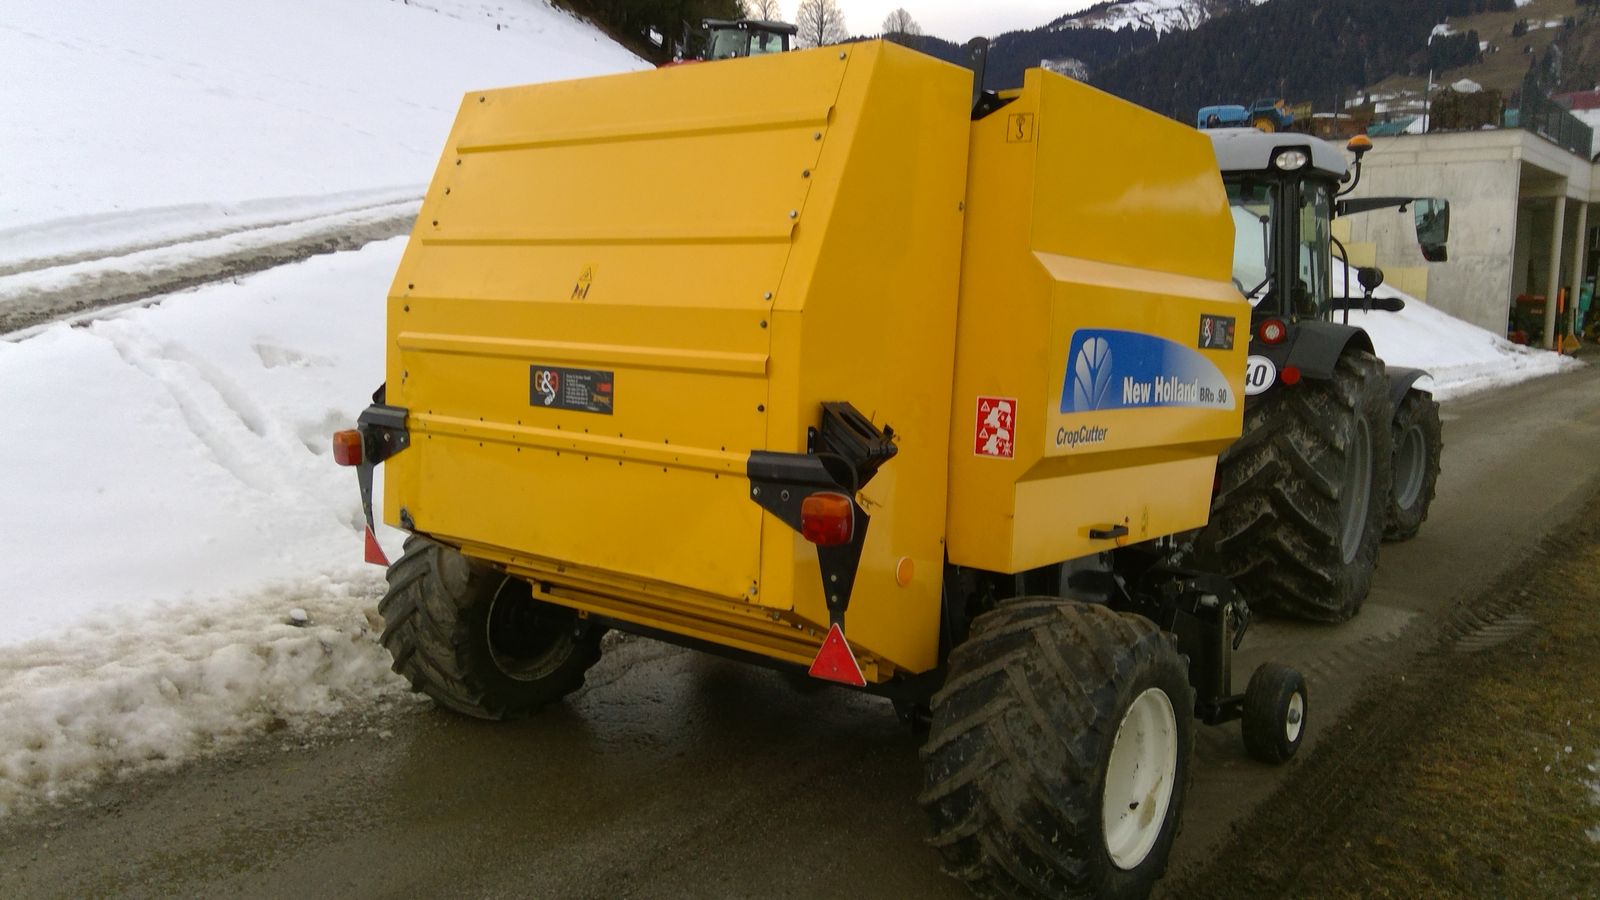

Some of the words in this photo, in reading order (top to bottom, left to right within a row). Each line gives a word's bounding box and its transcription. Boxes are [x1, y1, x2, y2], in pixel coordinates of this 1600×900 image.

[1122, 375, 1152, 405] New
[1154, 375, 1199, 403] Holland
[1056, 424, 1109, 449] CropCutter
